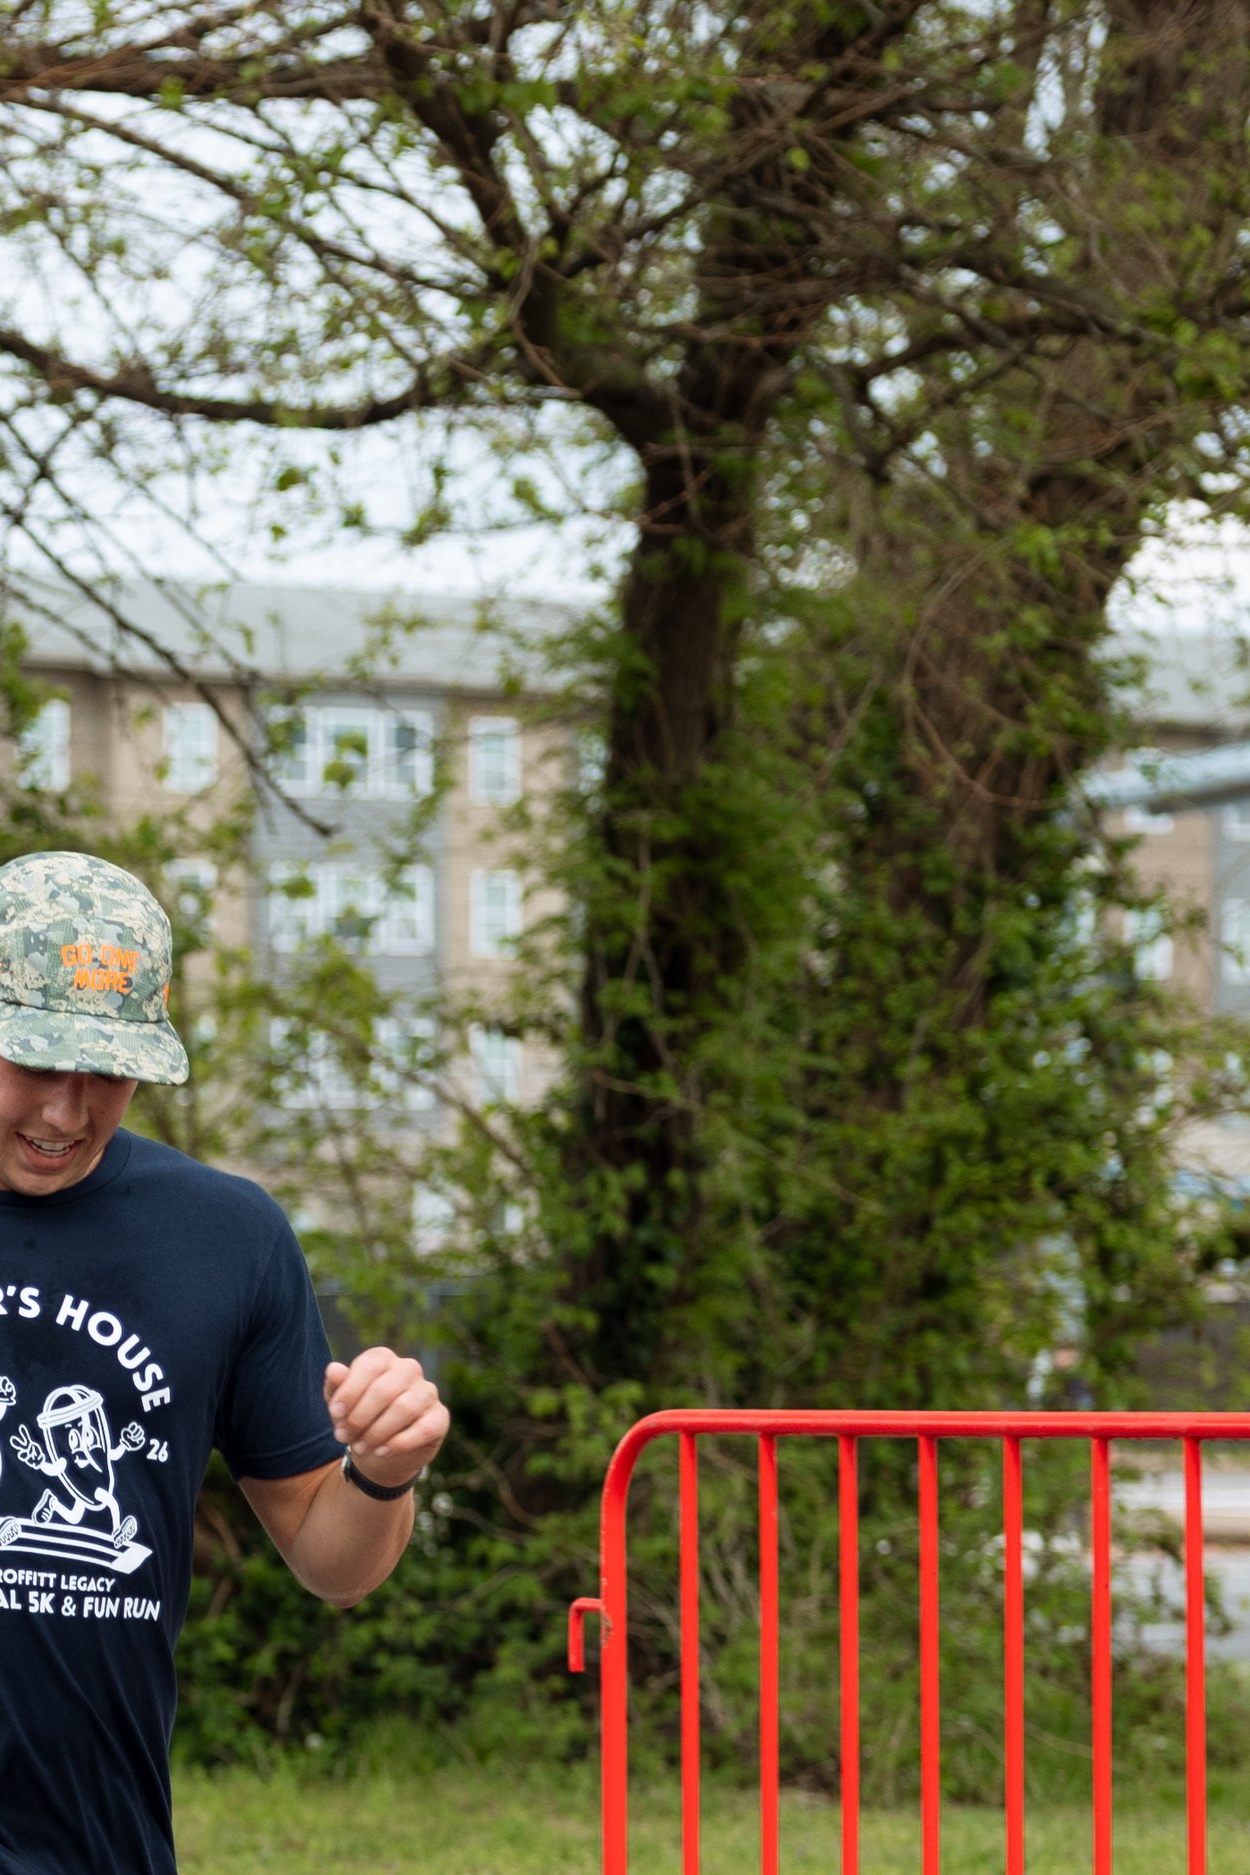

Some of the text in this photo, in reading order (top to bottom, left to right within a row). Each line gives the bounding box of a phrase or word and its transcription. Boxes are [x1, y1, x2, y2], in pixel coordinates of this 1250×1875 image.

[60, 943, 141, 974] GO ONE
[73, 968, 131, 994] MORE
[55, 1294, 171, 1412] HOUSE
[146, 1438, 169, 1463] 26
[60, 1574, 116, 1593] LEGACY
[28, 1591, 55, 1615] 5K
[61, 1598, 76, 1617] &
[83, 1596, 118, 1619] FUN
[123, 1597, 161, 1622] RUN
